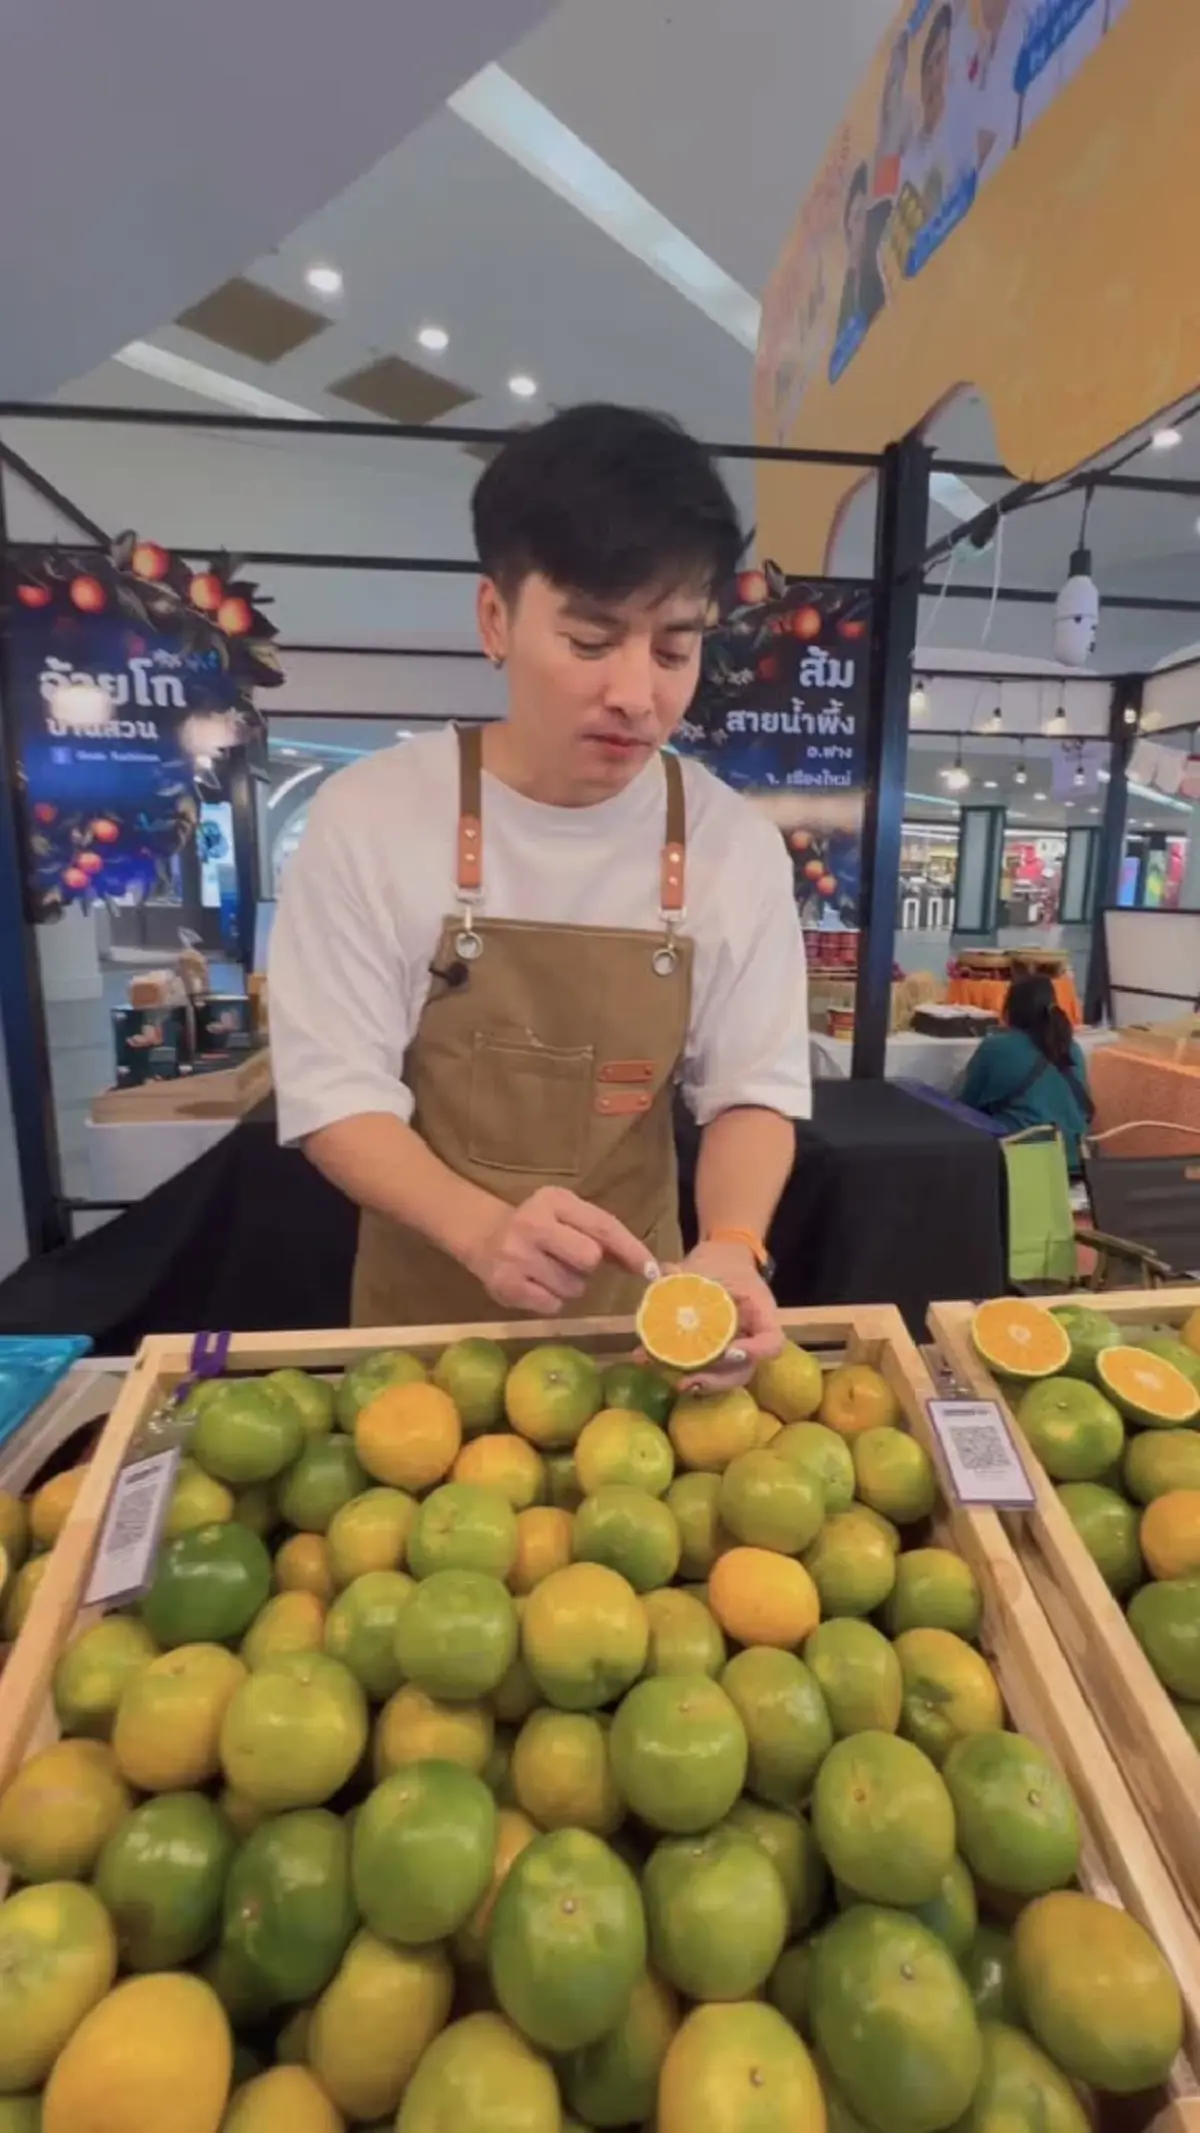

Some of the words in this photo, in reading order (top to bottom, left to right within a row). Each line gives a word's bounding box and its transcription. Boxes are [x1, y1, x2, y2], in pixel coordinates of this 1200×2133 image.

[799, 645, 855, 688] ส้ม
[726, 696, 855, 735] สายน้ำผึ้ง
